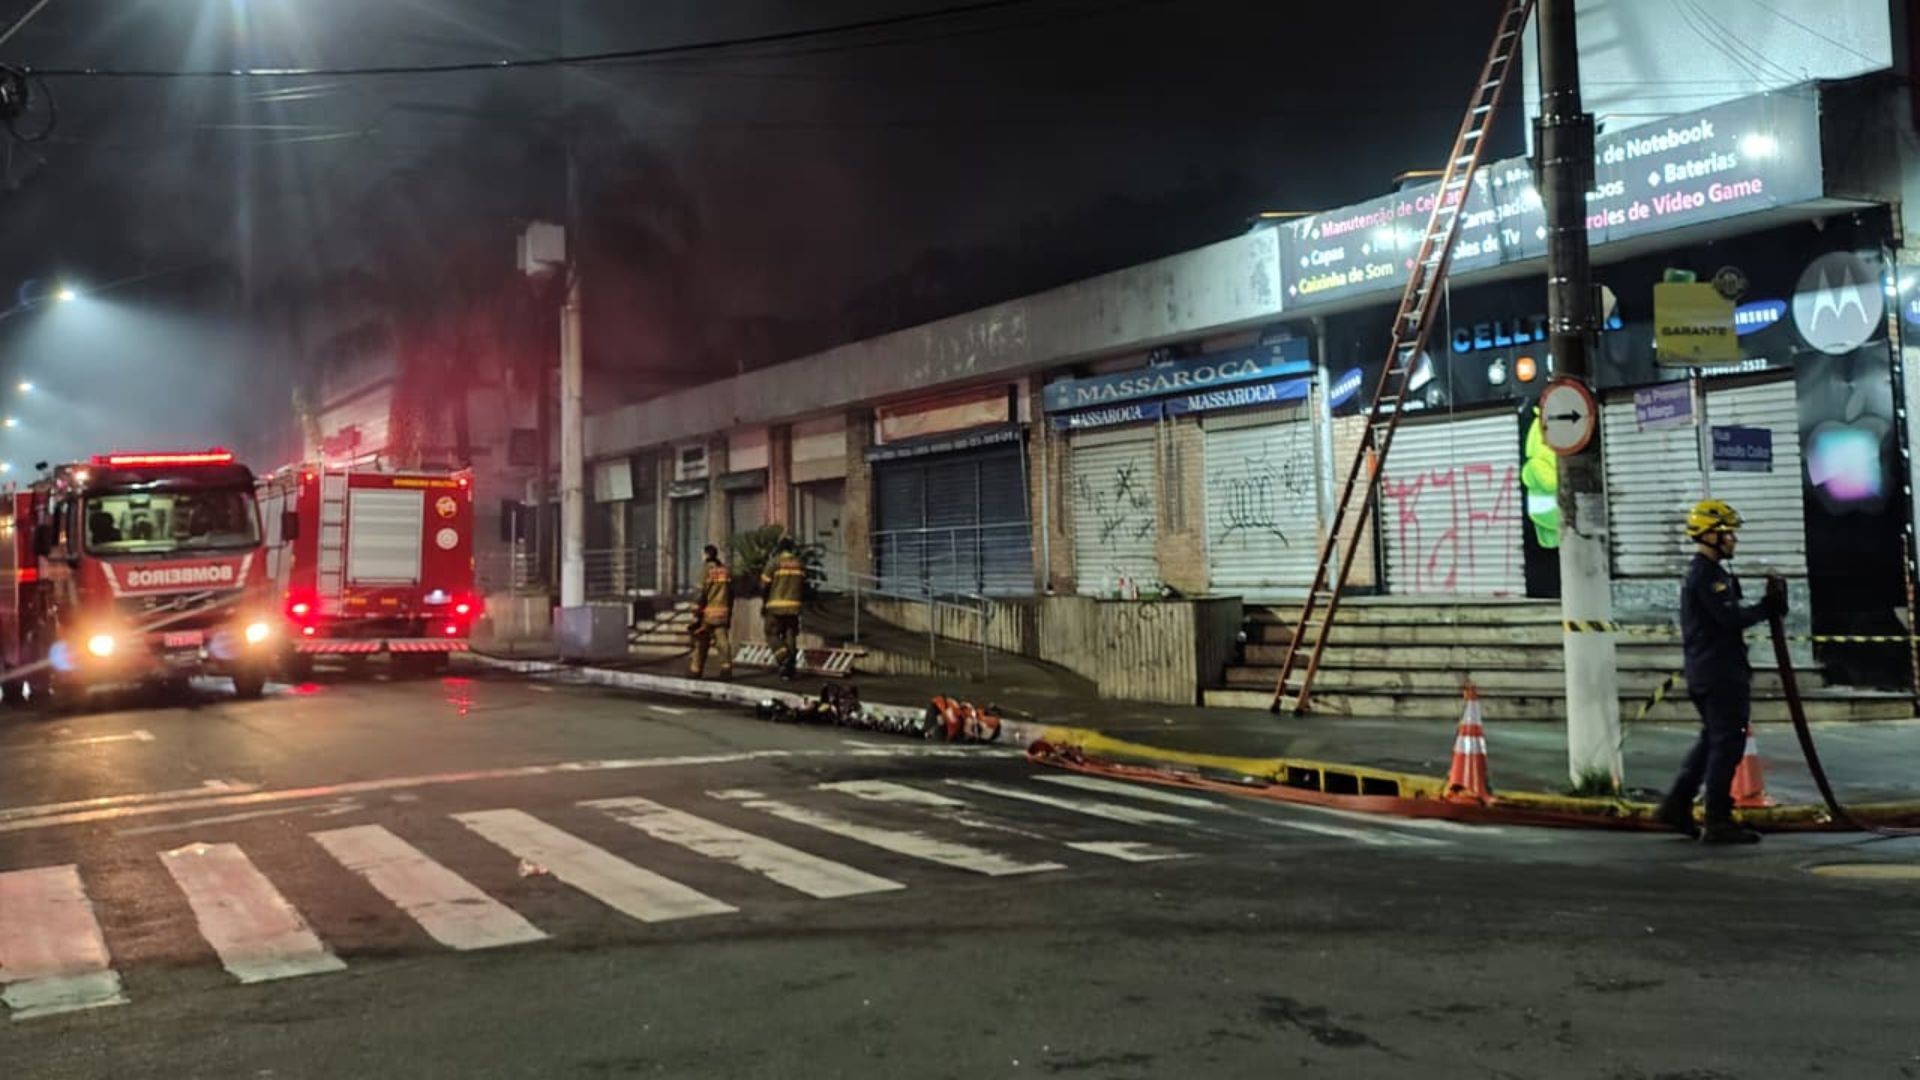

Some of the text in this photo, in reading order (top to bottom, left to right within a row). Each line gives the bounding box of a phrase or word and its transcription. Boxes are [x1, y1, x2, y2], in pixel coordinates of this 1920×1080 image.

[1604, 119, 1714, 165] de Notebook
[1664, 151, 1737, 184] Baterias
[1628, 199, 1649, 221] de
[1708, 177, 1763, 203] Game
[1321, 206, 1395, 238] Manutenção
[1397, 200, 1413, 218] de
[1502, 229, 1520, 246] Tv
[1311, 246, 1345, 267] Capas
[1299, 261, 1394, 294] Caixinha de Som
[1661, 325, 1728, 337] GARANTE
[1076, 358, 1262, 405] MASSAROCA
[1187, 384, 1278, 411] MASSAROCA
[1069, 405, 1143, 427] MASSAROCA
